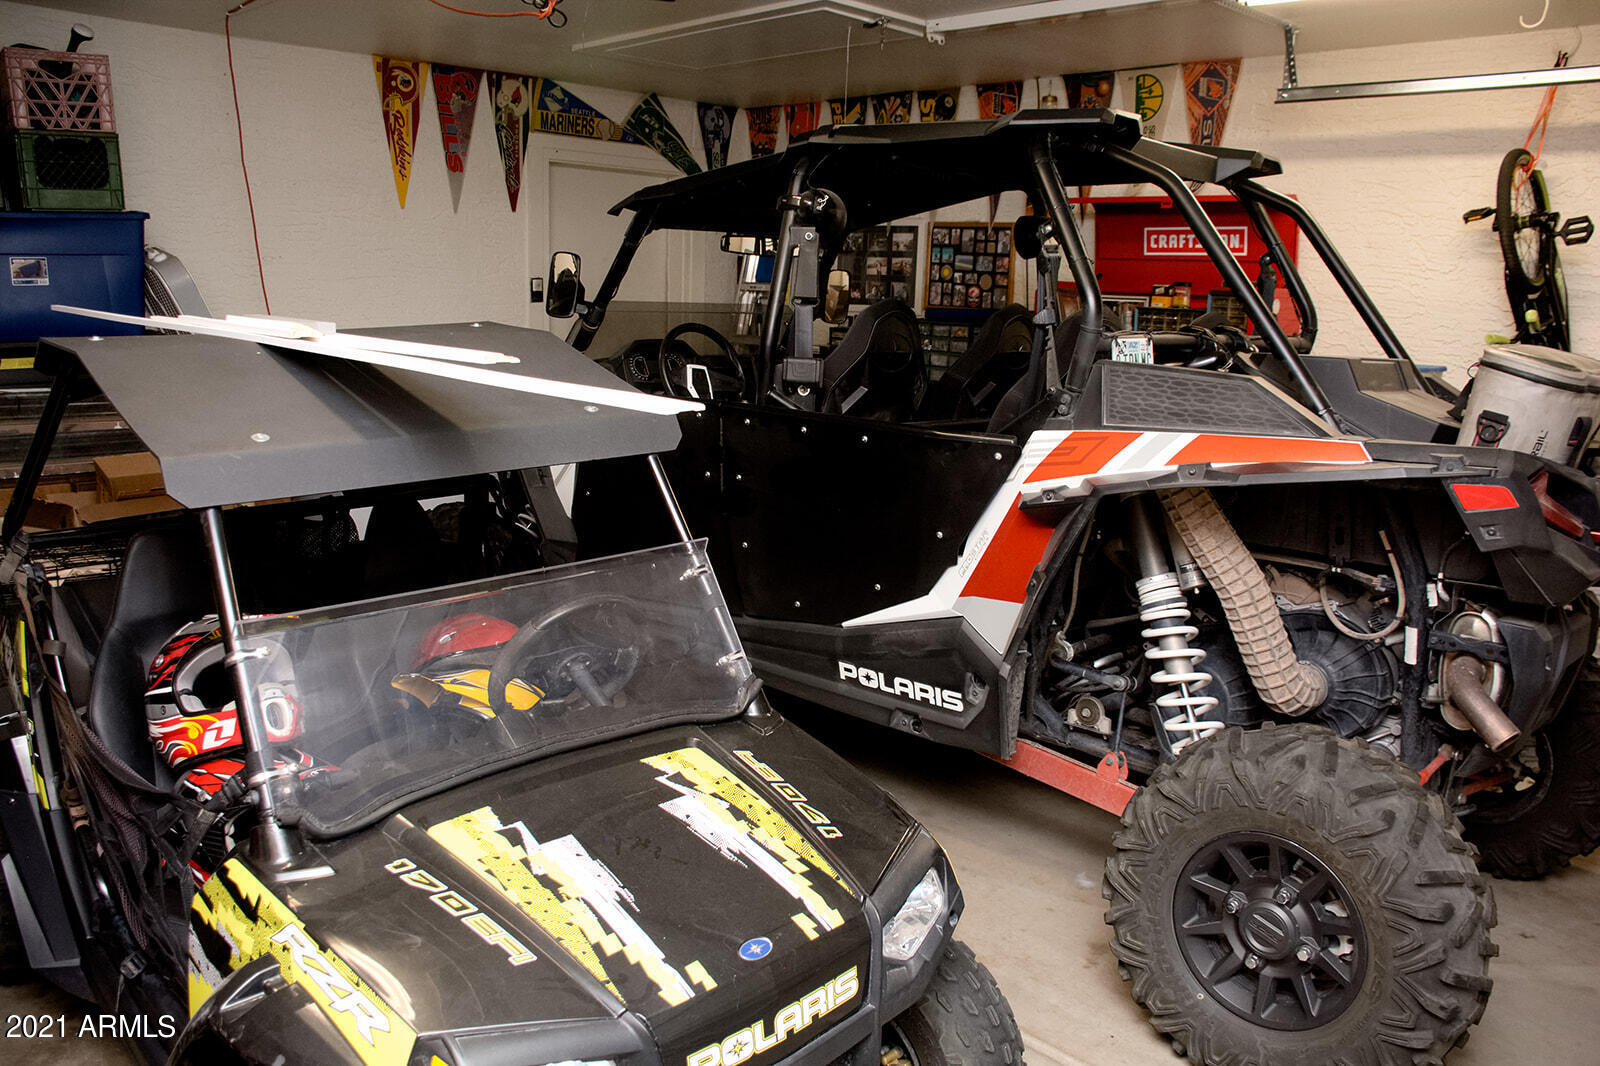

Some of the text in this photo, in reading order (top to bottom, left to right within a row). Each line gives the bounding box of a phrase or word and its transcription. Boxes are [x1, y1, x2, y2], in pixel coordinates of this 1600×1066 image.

[432, 67, 464, 174] BILLS
[540, 109, 595, 137] MARINERS
[1150, 234, 1239, 248] CRAFTN
[838, 661, 965, 713] POLARIS
[270, 922, 391, 1047] RZR
[685, 966, 860, 1066] POLARIS
